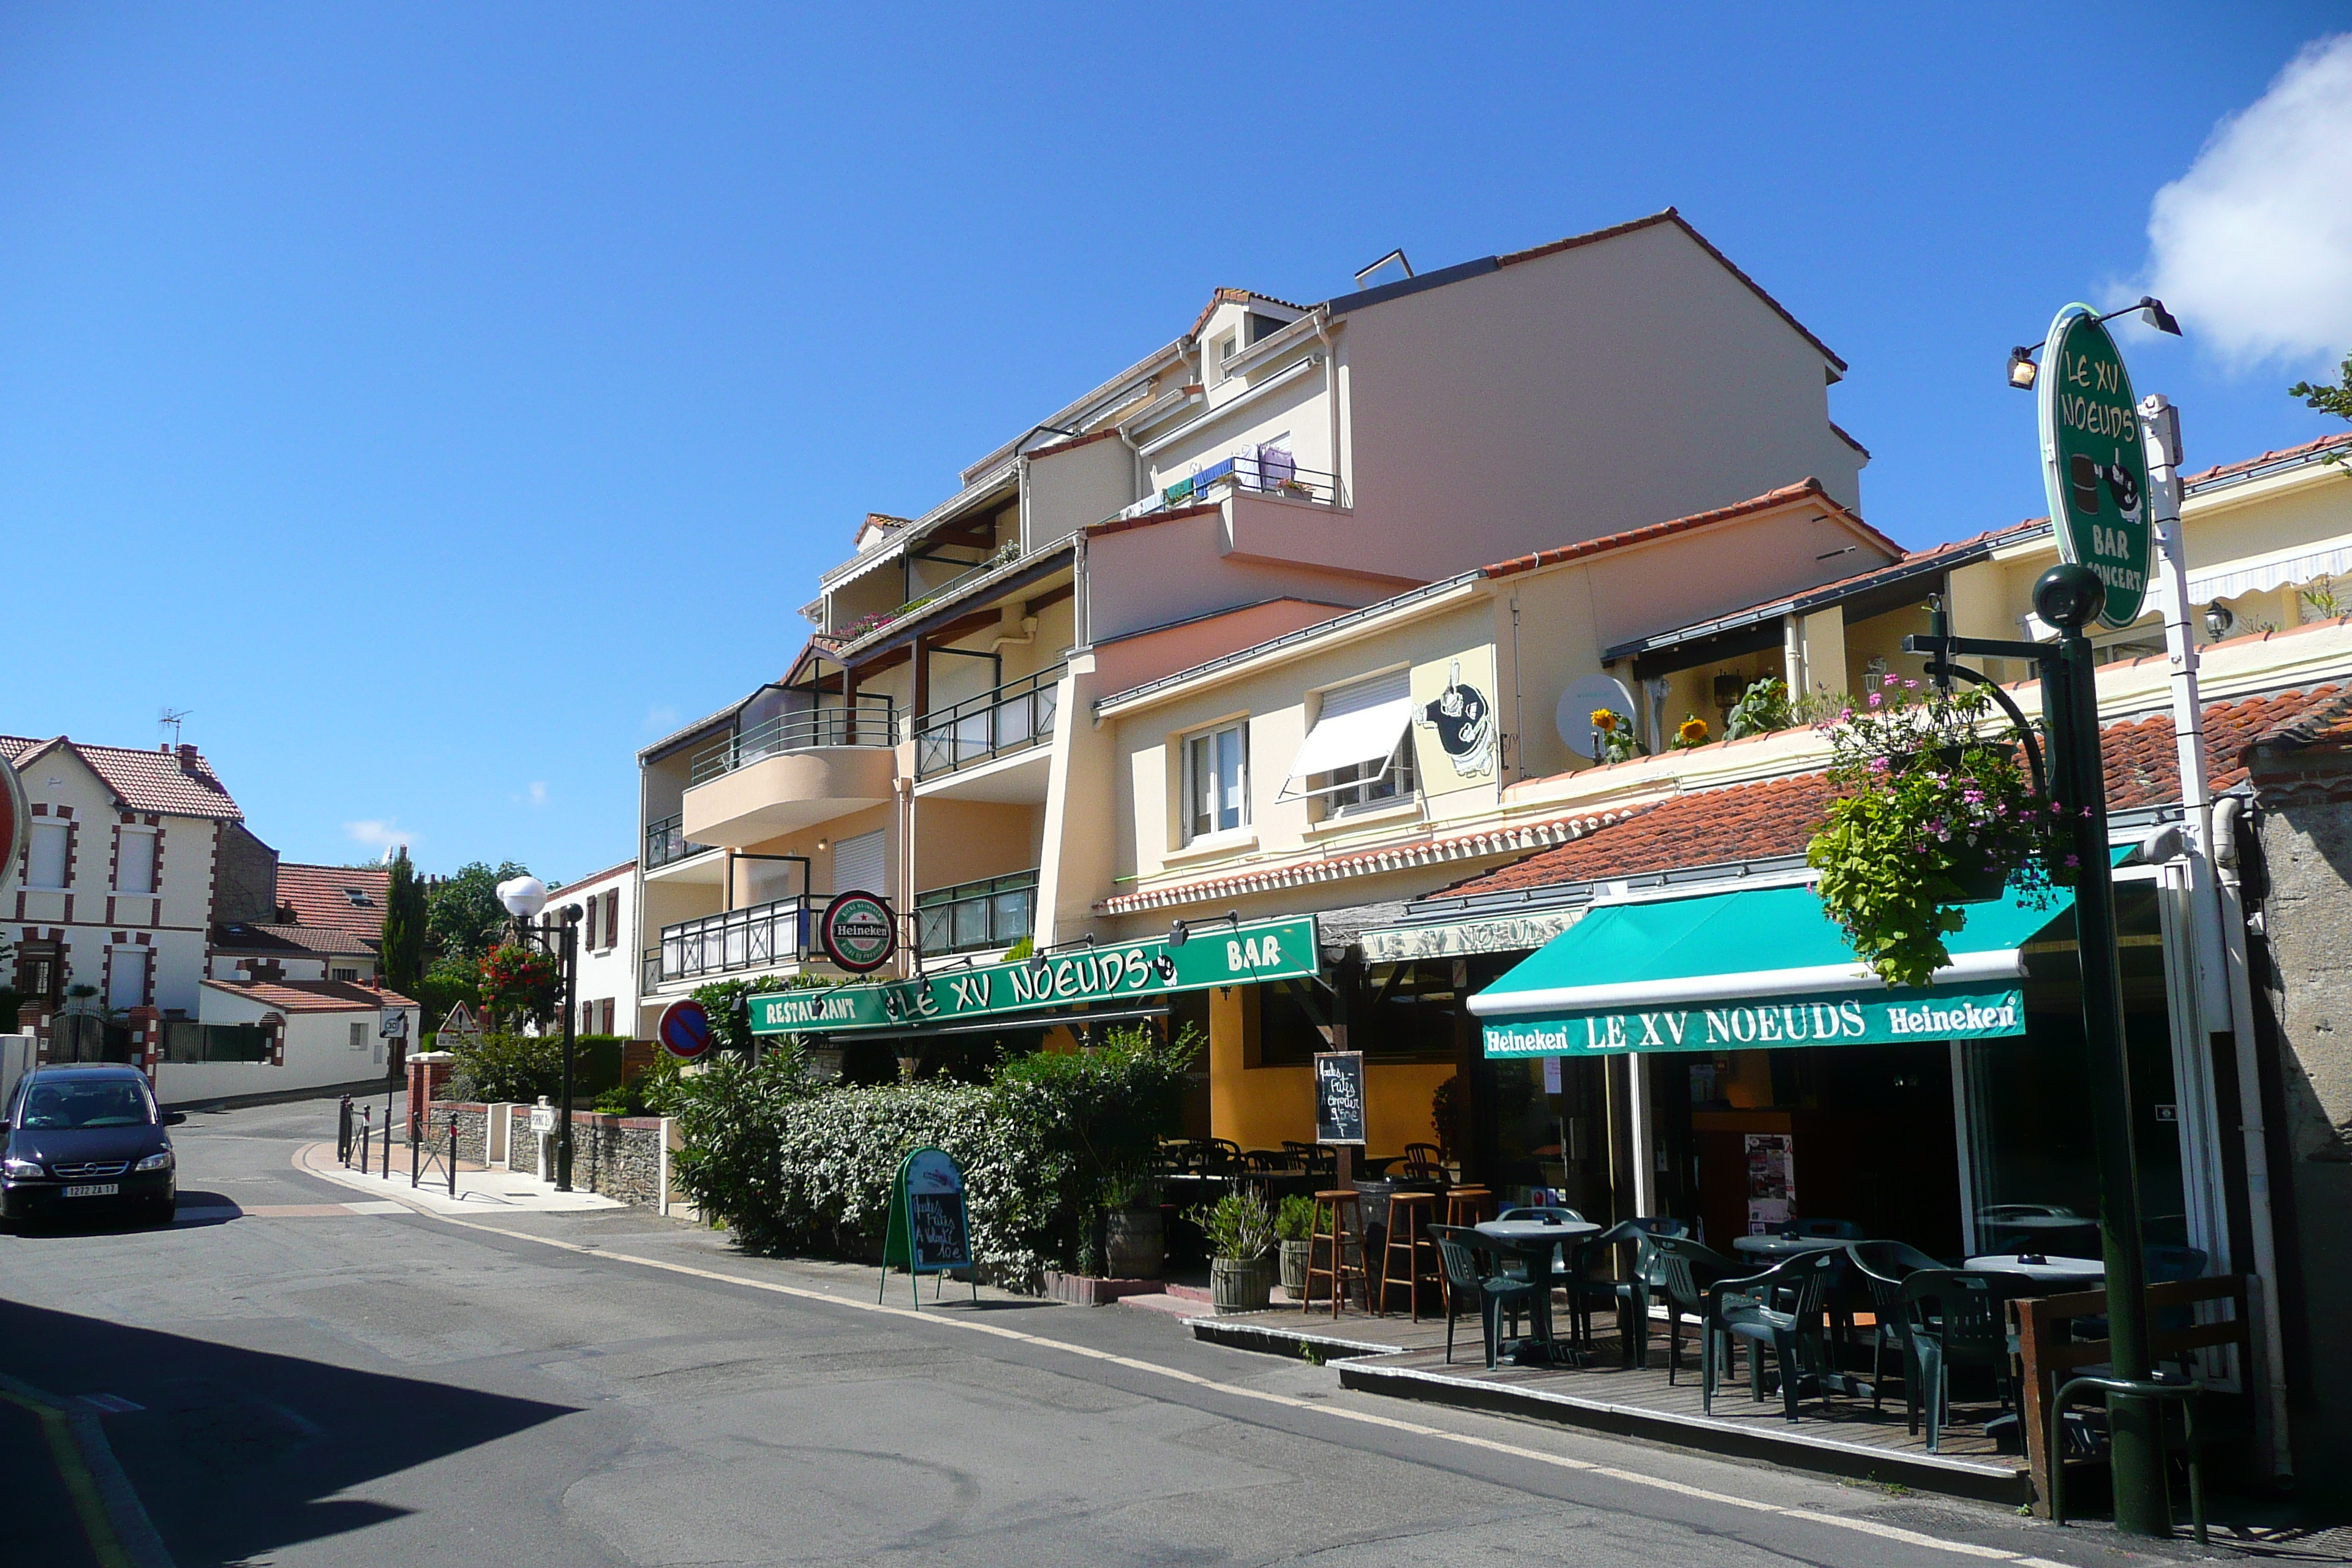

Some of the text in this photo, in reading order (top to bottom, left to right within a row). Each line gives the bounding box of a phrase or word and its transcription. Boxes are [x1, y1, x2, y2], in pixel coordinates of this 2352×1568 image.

[2065, 351, 2119, 395] LE XV
[2061, 394, 2136, 442] NOEUDS
[2092, 525, 2130, 562] BAR
[837, 925, 887, 936] Heineken
[766, 935, 1284, 1024] RESTAURANT LE XV NOEUDS BAR
[1485, 999, 2017, 1052] Heineken LE XV NOEUDS Heineken
[106, 1185, 115, 1193] 17
